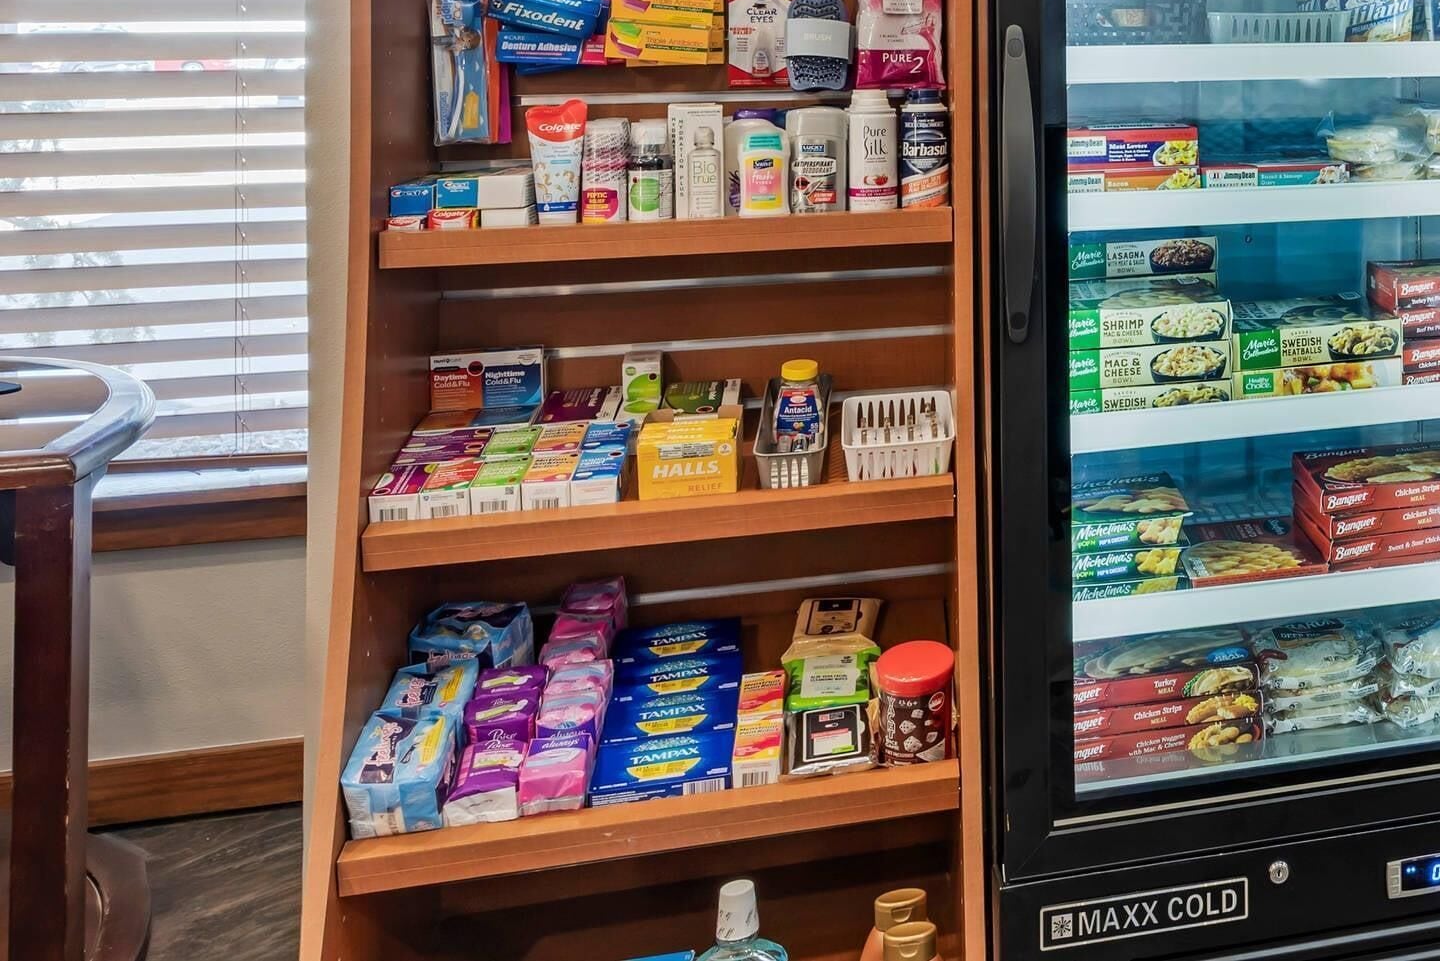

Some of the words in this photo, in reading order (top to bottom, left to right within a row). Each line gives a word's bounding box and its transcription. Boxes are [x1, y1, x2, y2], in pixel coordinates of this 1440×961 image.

[503, 2, 585, 31] Fixodent
[746, 8, 778, 16] CLEAR
[750, 16, 774, 24] EYES
[803, 32, 833, 41] BRUSH
[501, 41, 538, 51] Denture
[537, 42, 578, 52] Adhesive
[882, 53, 912, 63] PURE
[910, 56, 924, 74] 2
[538, 121, 582, 133] Colgate
[863, 125, 887, 139] Pure
[863, 138, 889, 160] Silk
[902, 141, 948, 157] Barbasol
[692, 160, 717, 175] Bio
[793, 160, 834, 168] ANTIPERSPIRANT
[692, 174, 717, 185] true
[1075, 249, 1104, 262] Marie
[1106, 250, 1146, 261] LASAGNA
[1116, 266, 1137, 274] BOWL
[1400, 281, 1436, 296] Banquet
[1400, 310, 1437, 326] Banquet
[1102, 319, 1145, 331] SHRIMP
[1103, 330, 1117, 338] MAC
[1122, 329, 1144, 337] CHEESE
[1247, 337, 1277, 349] Marie
[1281, 336, 1323, 349] SWEDISH
[1281, 346, 1323, 357] MEATBALLS
[1103, 357, 1130, 368] MAC
[1132, 357, 1141, 366] &
[1292, 355, 1313, 363] BOWL
[433, 374, 468, 383] Daytime
[485, 370, 526, 380] Nighttime
[1103, 367, 1142, 378] CHEESE
[1112, 376, 1135, 384] BOWL
[1245, 382, 1273, 391] Choice
[1103, 397, 1147, 409] SWEDISH
[783, 405, 813, 414] Antacid
[652, 459, 721, 480] HALLS
[687, 482, 724, 493] RELIEF
[1394, 486, 1421, 498] Chicken
[1421, 483, 1440, 495] Strips
[1326, 490, 1370, 511] Banquet
[1410, 494, 1426, 502] MEAL
[1402, 509, 1429, 522] Chicken
[1417, 517, 1433, 526] MEAL
[1076, 521, 1137, 541] Michelina's
[1335, 516, 1378, 536] Banquet
[1334, 541, 1377, 562] Banquet
[1387, 543, 1404, 553] Sweet
[1410, 539, 1425, 548] Sour
[1074, 552, 1135, 572] Michelina's
[650, 630, 708, 646] TAMPAX
[649, 666, 709, 683] TAMPAX
[1153, 677, 1178, 688] Turkey
[1157, 686, 1175, 695] MEAL
[639, 702, 706, 721] TAMPAX
[1133, 708, 1161, 721] Chicken
[1161, 704, 1183, 716] Strips
[542, 738, 580, 749] always
[1135, 737, 1162, 749] Chicken
[1161, 732, 1186, 744] Nuggets
[1163, 740, 1186, 750] Cheese
[629, 745, 700, 765] TAMPAX
[1078, 899, 1160, 938] MAXX
[1168, 887, 1238, 923] COLD
